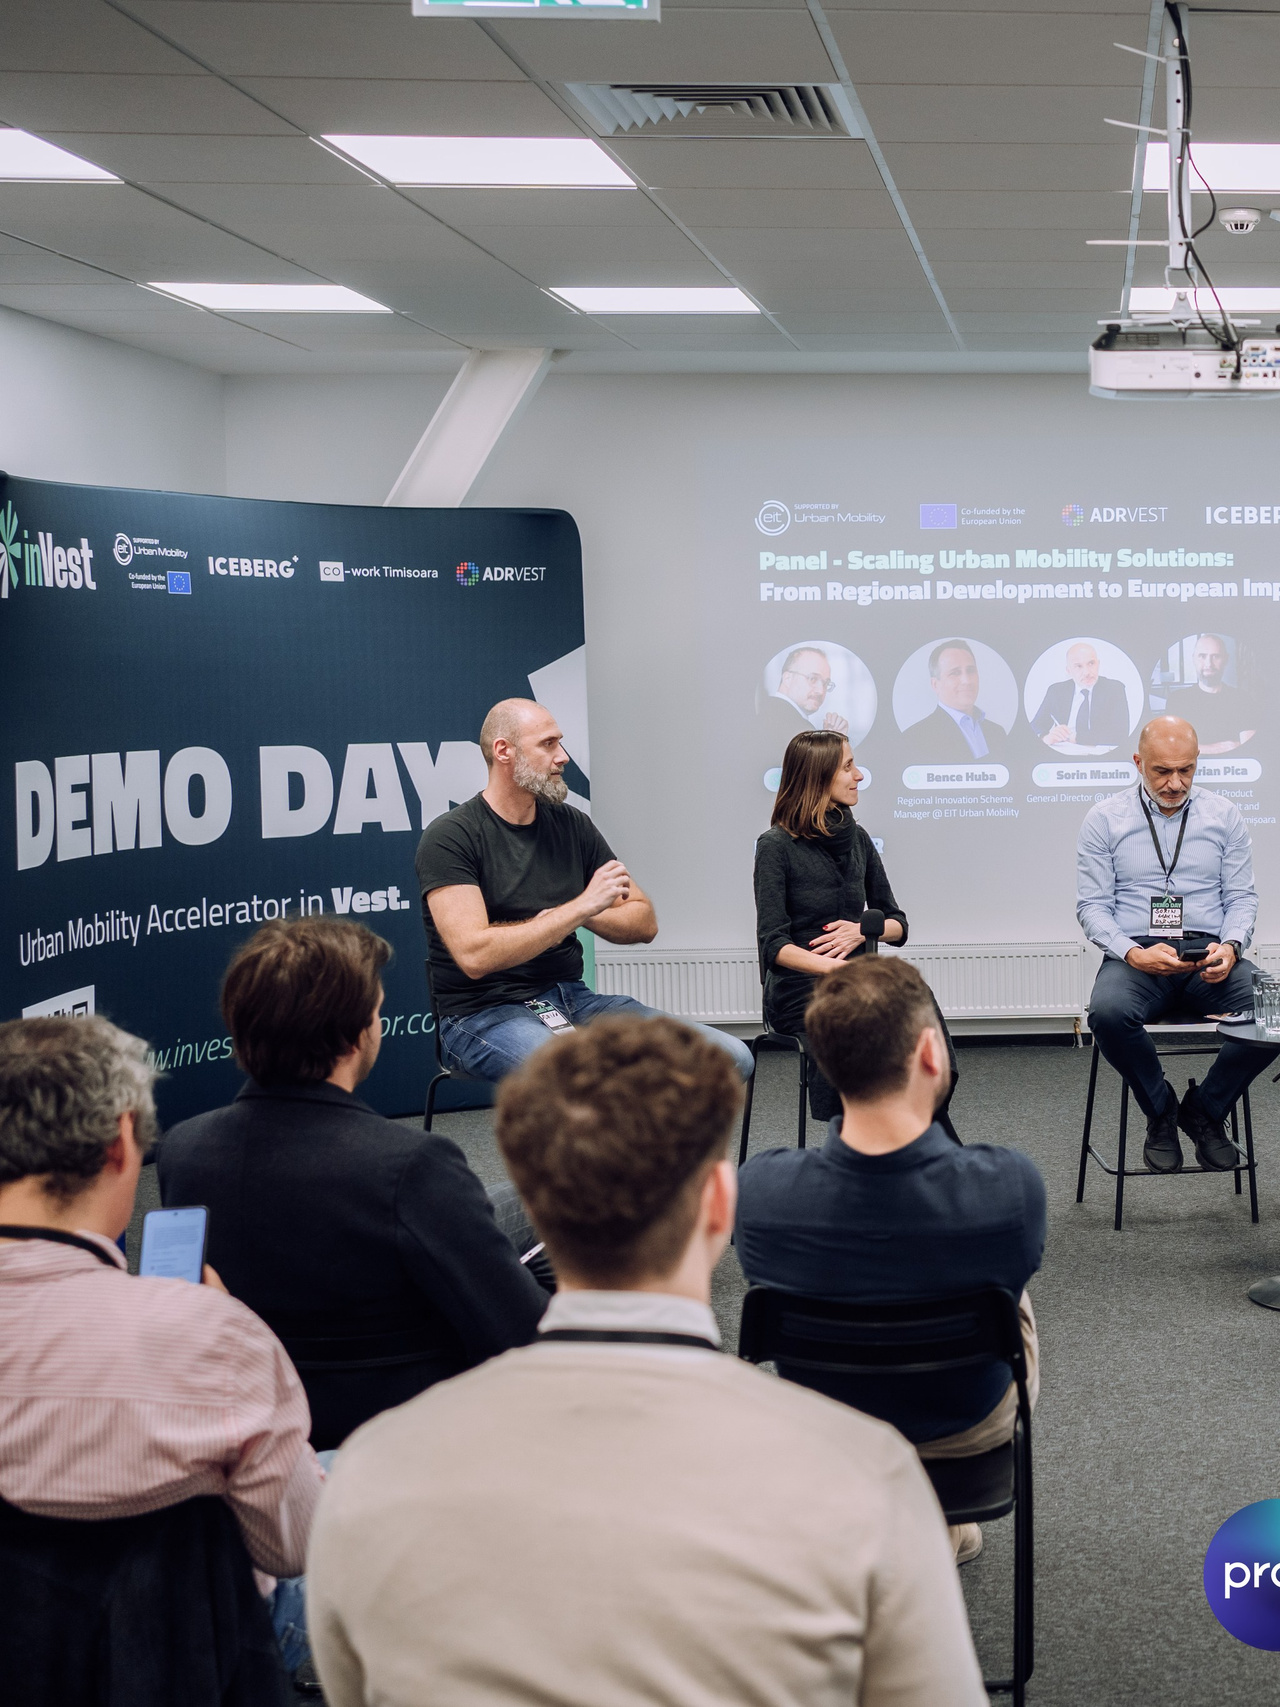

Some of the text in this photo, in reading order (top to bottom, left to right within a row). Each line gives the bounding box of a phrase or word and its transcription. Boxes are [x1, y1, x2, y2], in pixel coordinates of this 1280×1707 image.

[763, 511, 886, 524] eit Urban Mobility
[961, 507, 1025, 518] Co-funded by the
[1089, 506, 1168, 524] ADRVEST
[961, 517, 1022, 527] European Union
[134, 547, 157, 556] Urban
[158, 547, 188, 559] Mobility
[24, 530, 97, 591] inVest
[760, 551, 827, 571] Panel
[848, 549, 935, 574] Scaling
[939, 549, 1010, 569] Urban
[1015, 548, 1112, 573] Mobility
[1117, 548, 1234, 568] Solutions:
[129, 572, 166, 582] Co-funded by the
[382, 565, 439, 579] Timisoara
[482, 566, 546, 582] ADRVEST
[132, 582, 152, 590] European
[760, 582, 821, 602] From
[827, 580, 931, 606] Regional
[936, 579, 1093, 604] Development
[1098, 581, 1123, 598] to
[1128, 579, 1238, 602] European
[1056, 769, 1130, 780] Sorin Maxim
[1195, 766, 1248, 776] rian Pica
[926, 772, 997, 783] Bence Huba
[1026, 794, 1058, 803] General
[1060, 793, 1092, 802] Director
[1221, 789, 1254, 798] Product
[16, 740, 478, 871] DEMO DAY
[897, 794, 1014, 806] Regional Innovation Scheme
[1244, 802, 1260, 811] and
[893, 807, 1019, 820] Manager @ EIT Urban Mobility
[1243, 815, 1276, 826] mișoara
[20, 885, 410, 967] Urban Mobility Accelerator in Vest.
